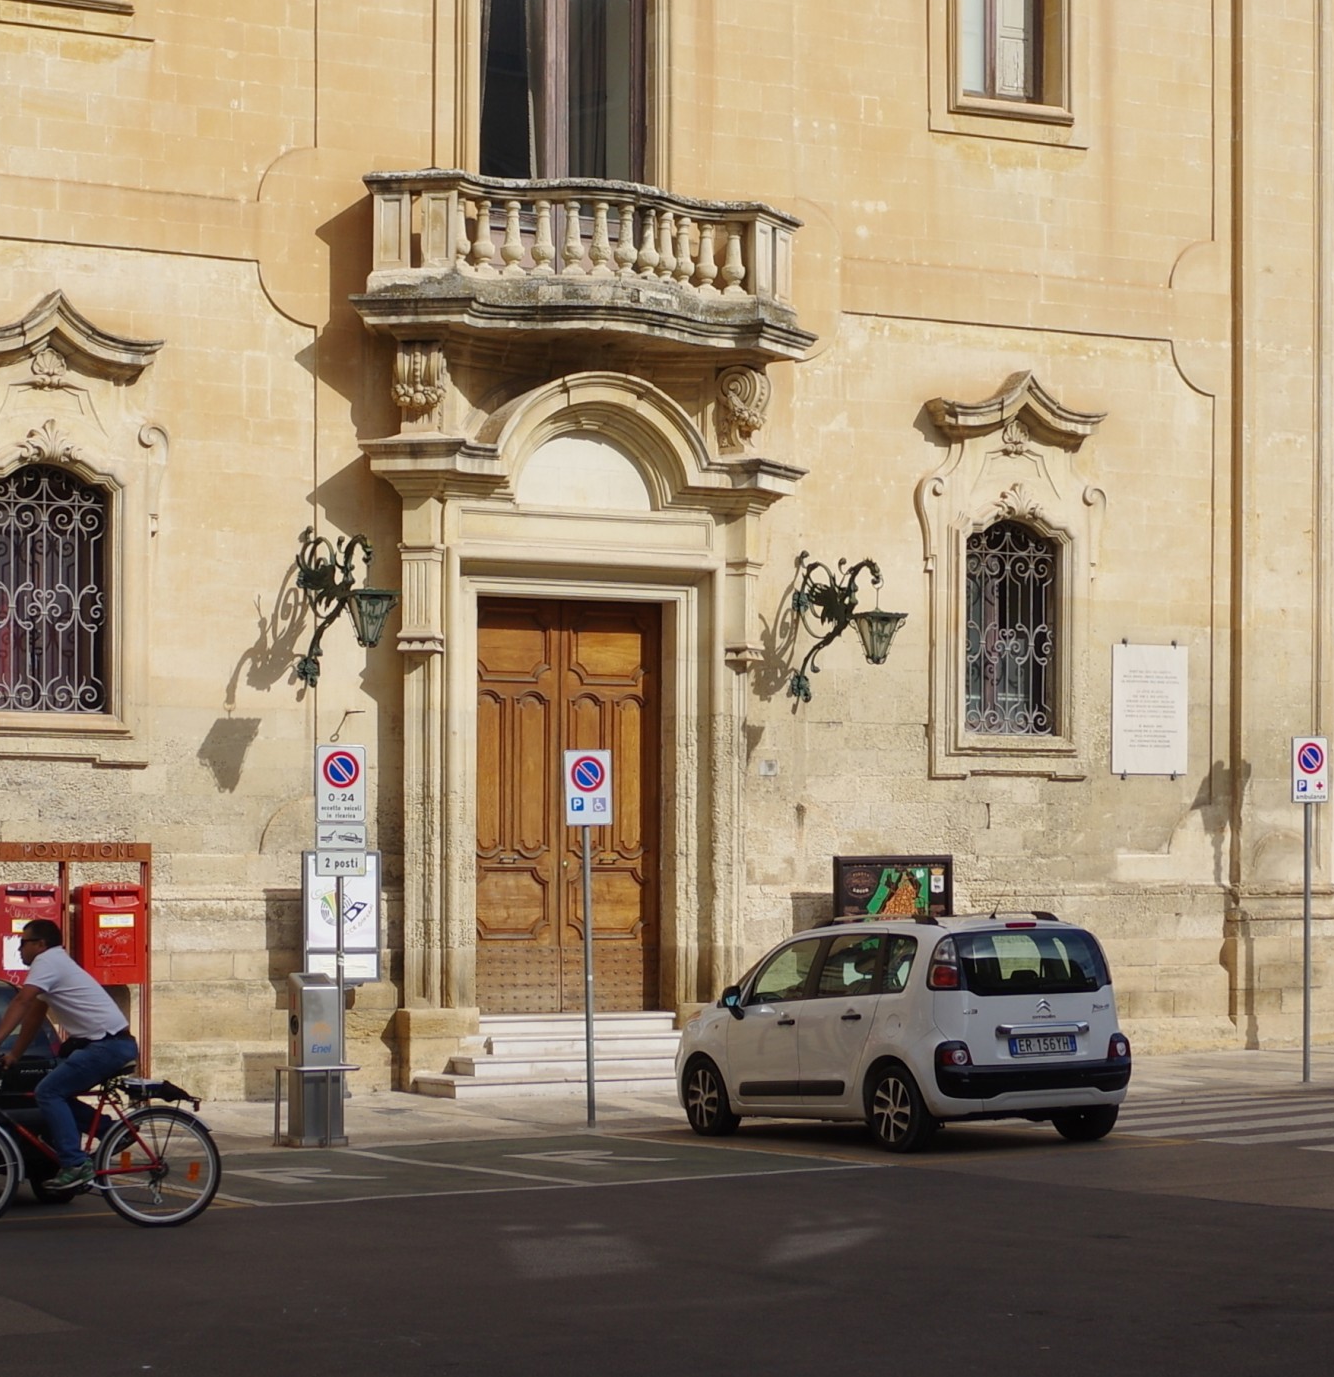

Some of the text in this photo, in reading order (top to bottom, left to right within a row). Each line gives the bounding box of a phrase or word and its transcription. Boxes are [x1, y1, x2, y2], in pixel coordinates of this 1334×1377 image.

[325, 857, 358, 870] 2 posti
[310, 1044, 332, 1054] Enel
[1018, 1036, 1069, 1053] ER 156YH
